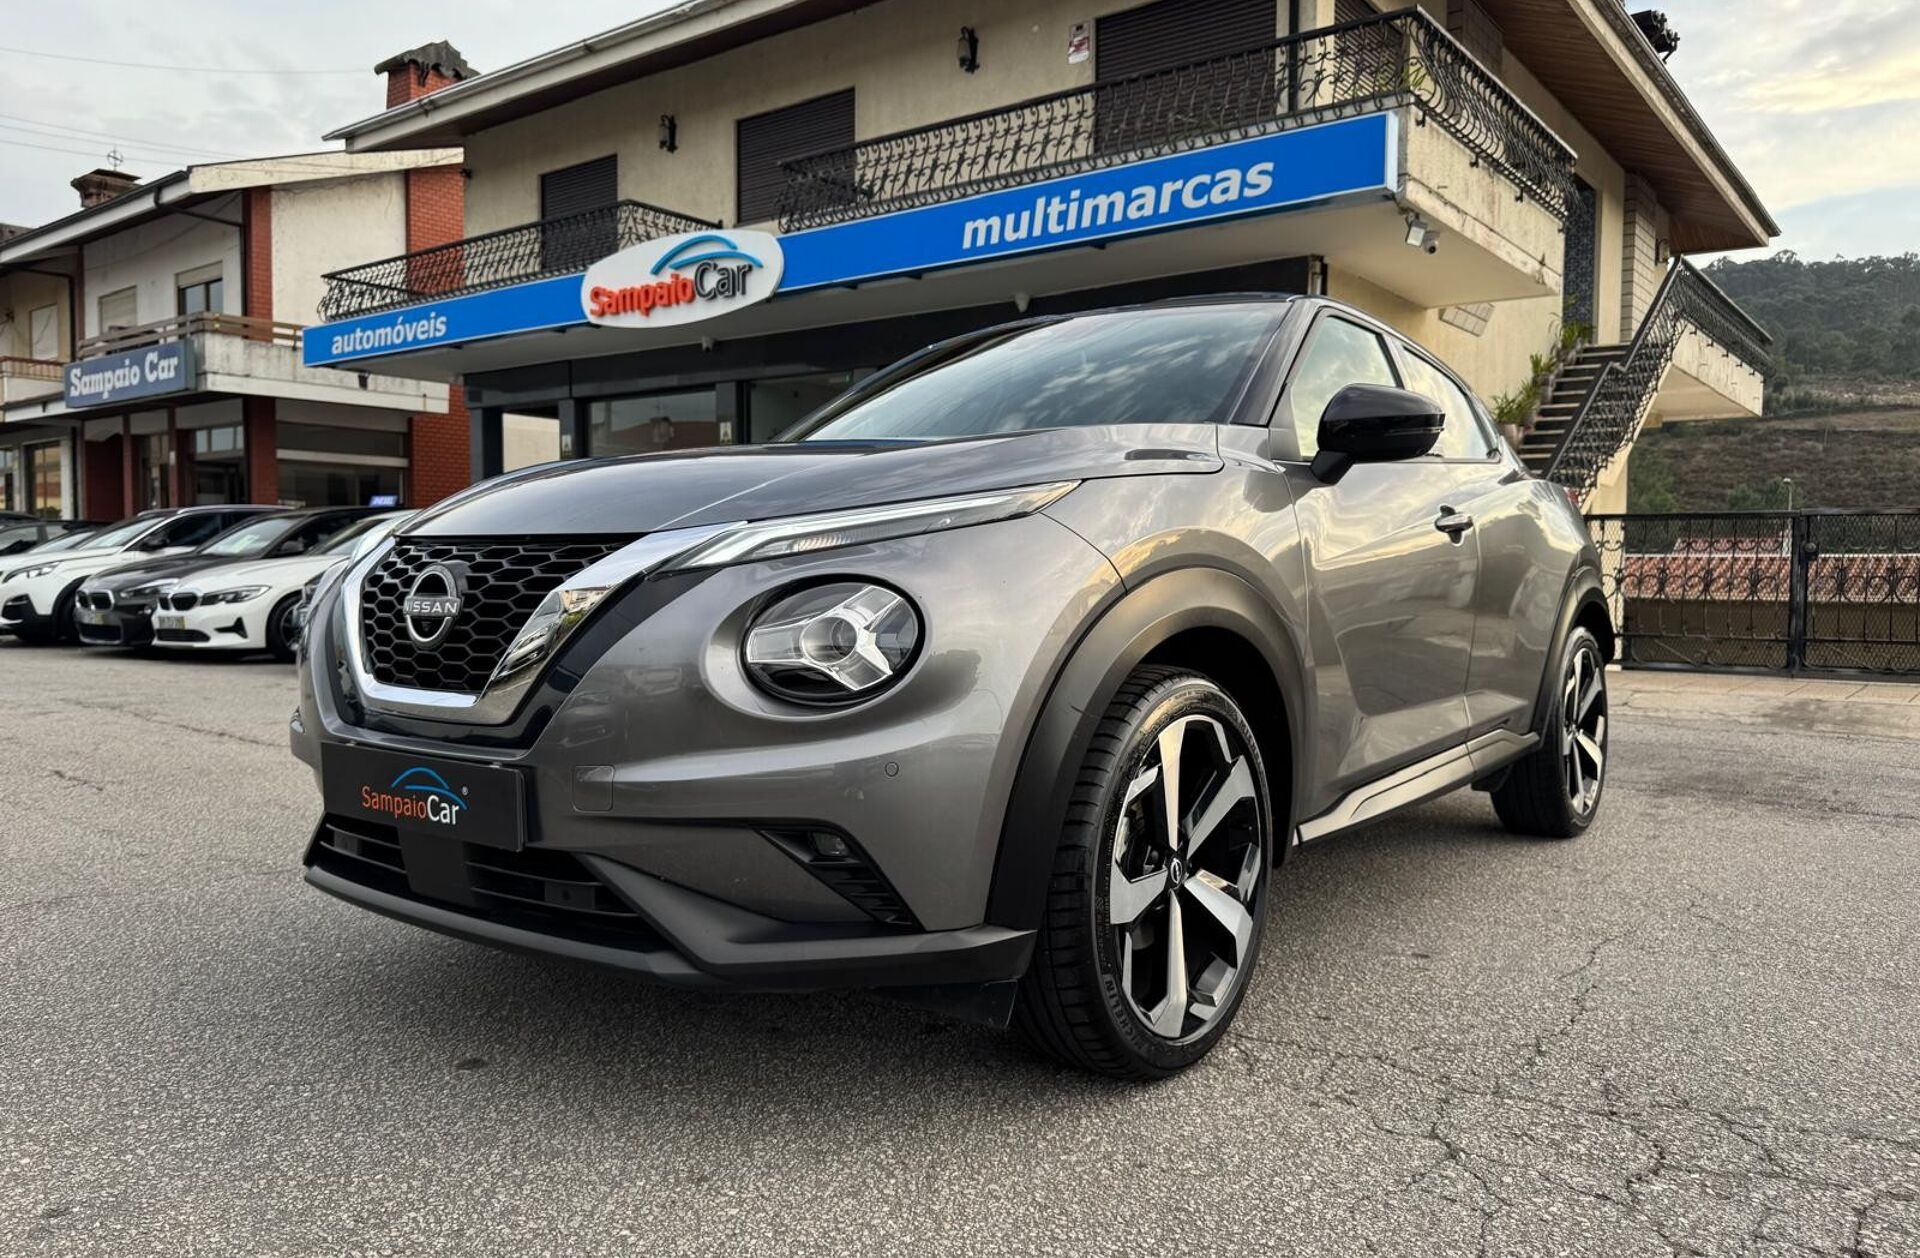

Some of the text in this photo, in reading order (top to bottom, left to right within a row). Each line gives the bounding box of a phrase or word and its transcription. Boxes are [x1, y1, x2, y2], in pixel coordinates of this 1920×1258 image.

[962, 161, 1275, 249] multimarcas
[590, 260, 754, 318] SampaioCar
[331, 311, 448, 355] automóveis
[70, 351, 178, 399] Sampaio Car
